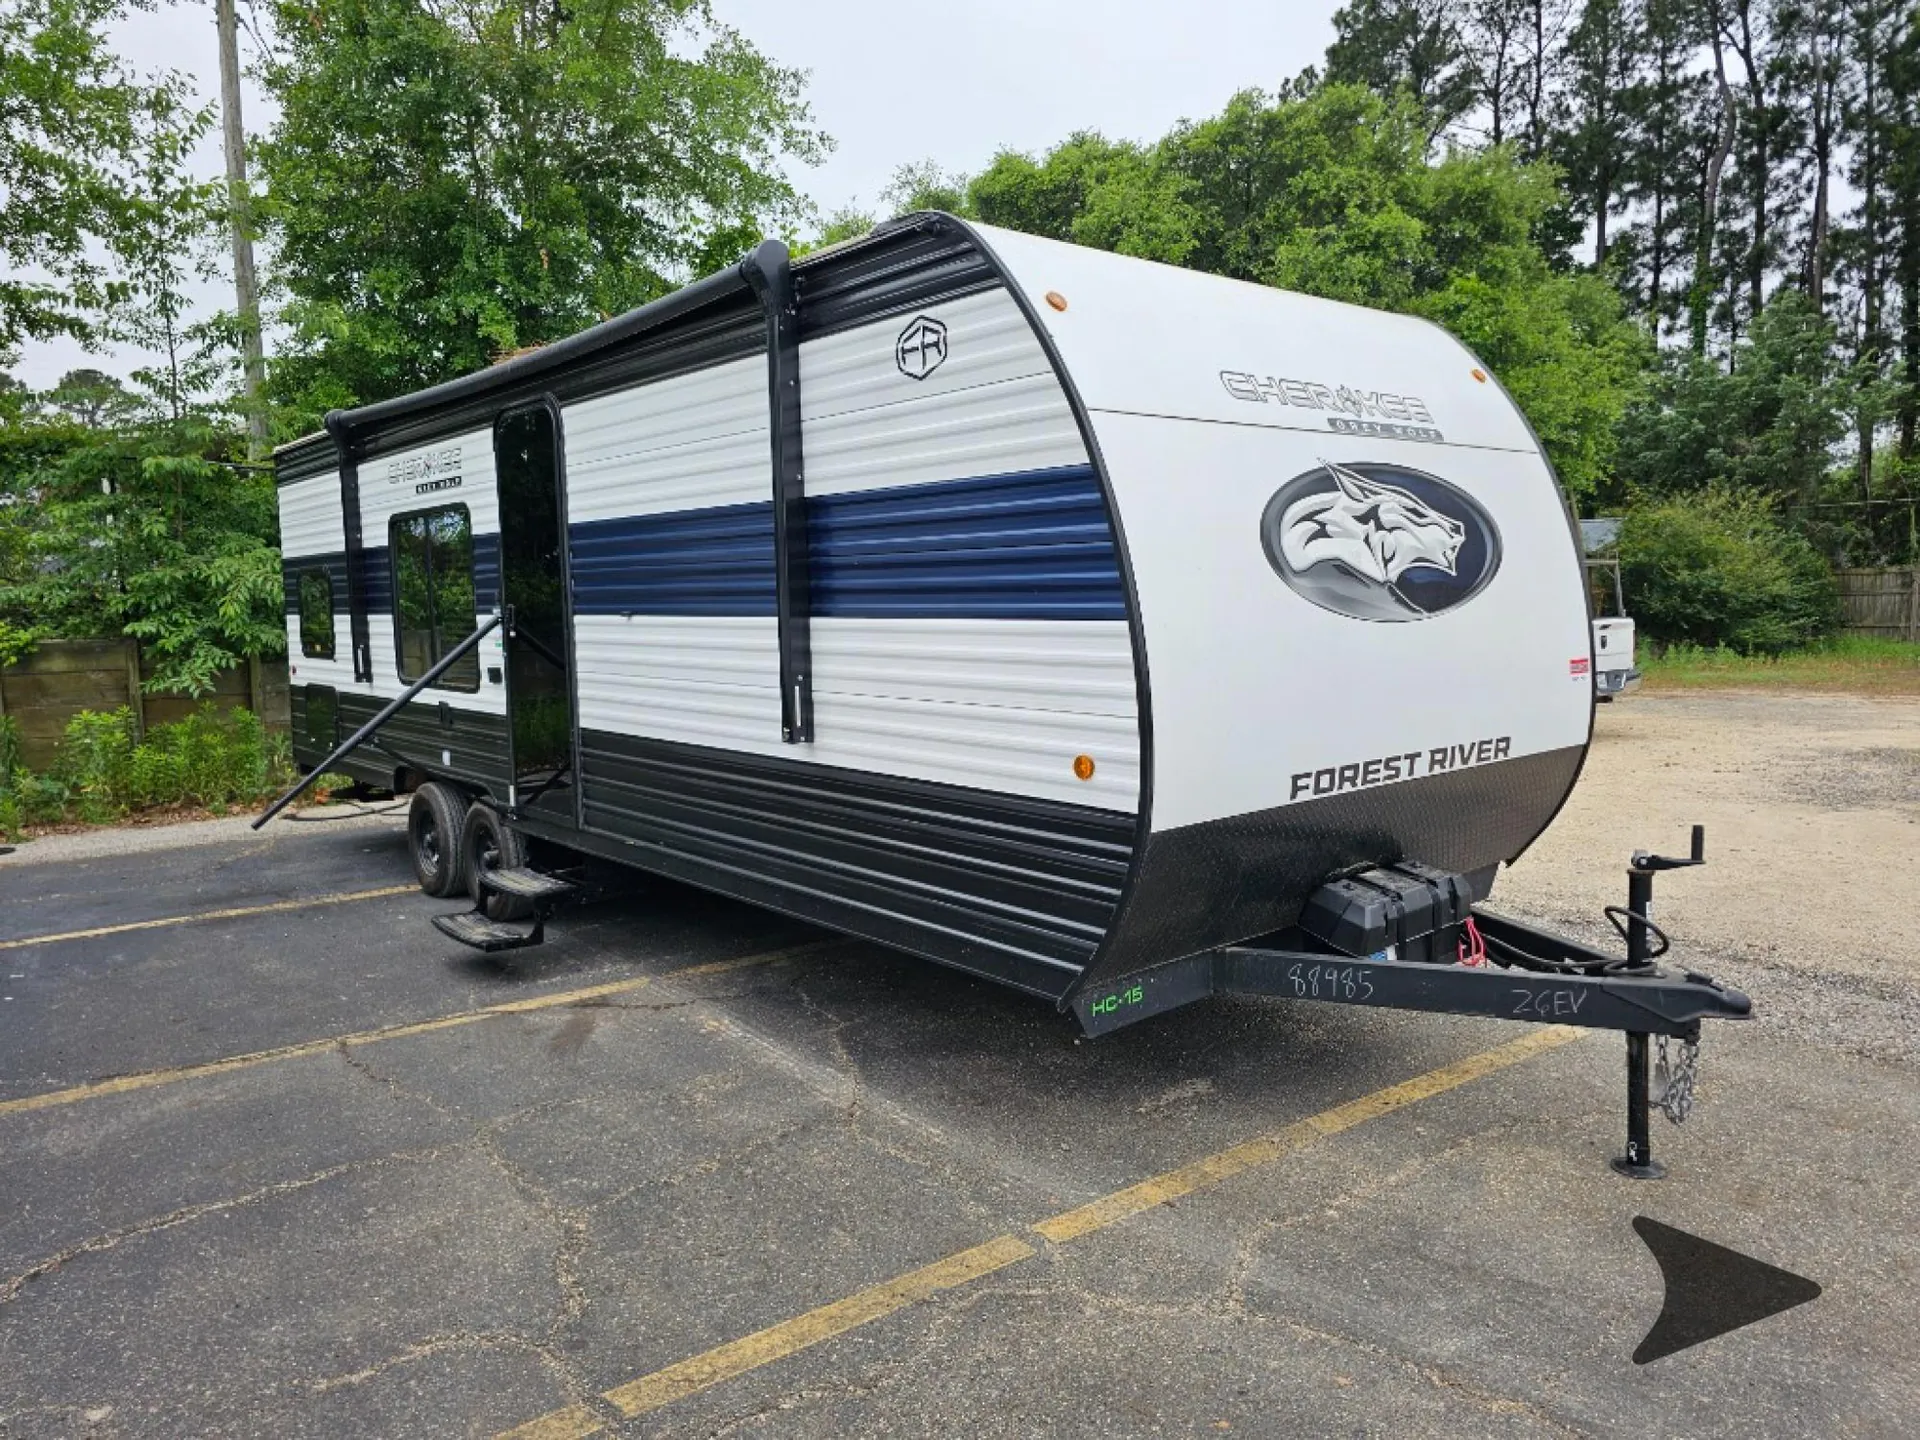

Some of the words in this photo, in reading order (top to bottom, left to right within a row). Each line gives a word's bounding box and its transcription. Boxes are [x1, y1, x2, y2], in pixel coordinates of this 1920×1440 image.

[1290, 751, 1422, 801] FOREST
[1428, 736, 1512, 773] RIVER
[1287, 963, 1374, 1000] 88985
[1511, 987, 1588, 1016] 26EV
